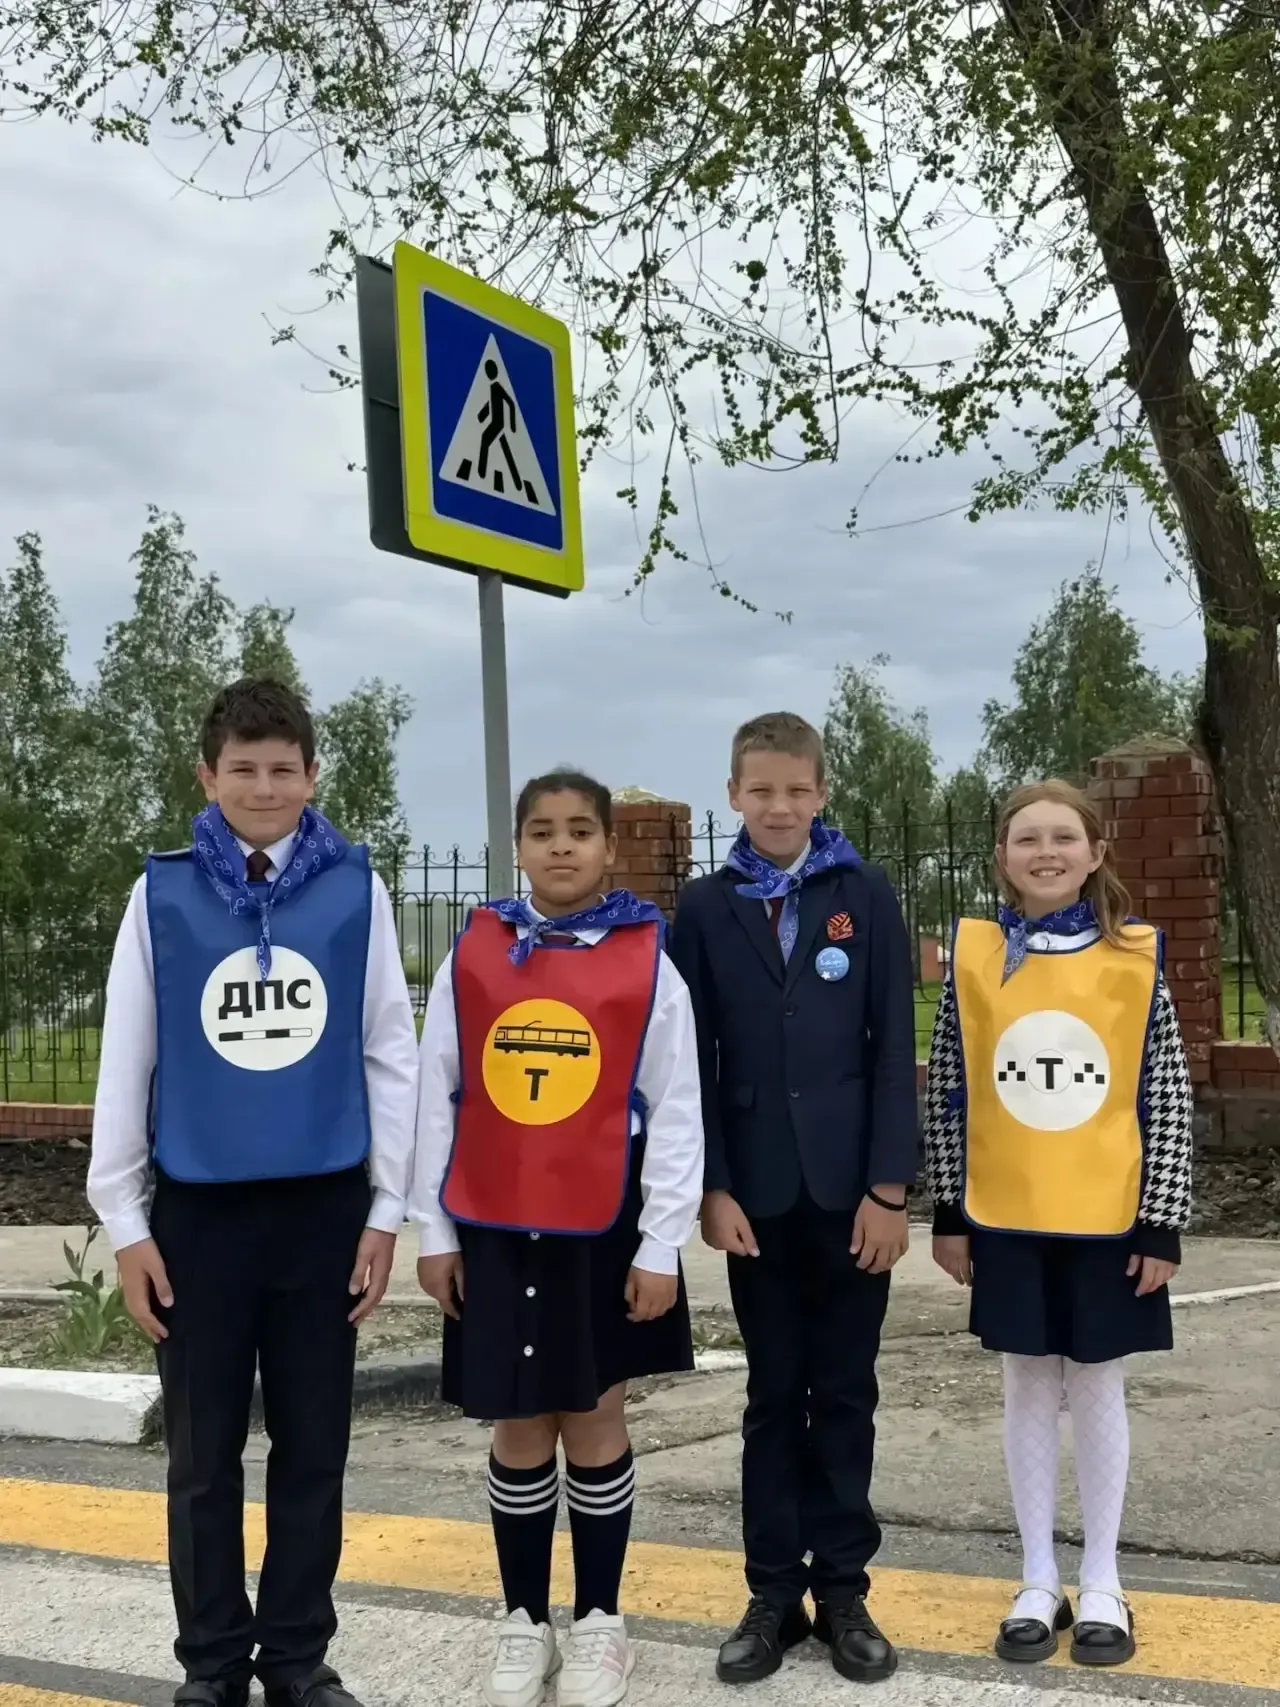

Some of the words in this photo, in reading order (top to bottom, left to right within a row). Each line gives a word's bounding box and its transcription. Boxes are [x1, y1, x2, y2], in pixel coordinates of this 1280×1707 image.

[218, 978, 311, 1020] ДПС
[524, 1067, 549, 1101] Т
[1036, 1057, 1063, 1090] Т
